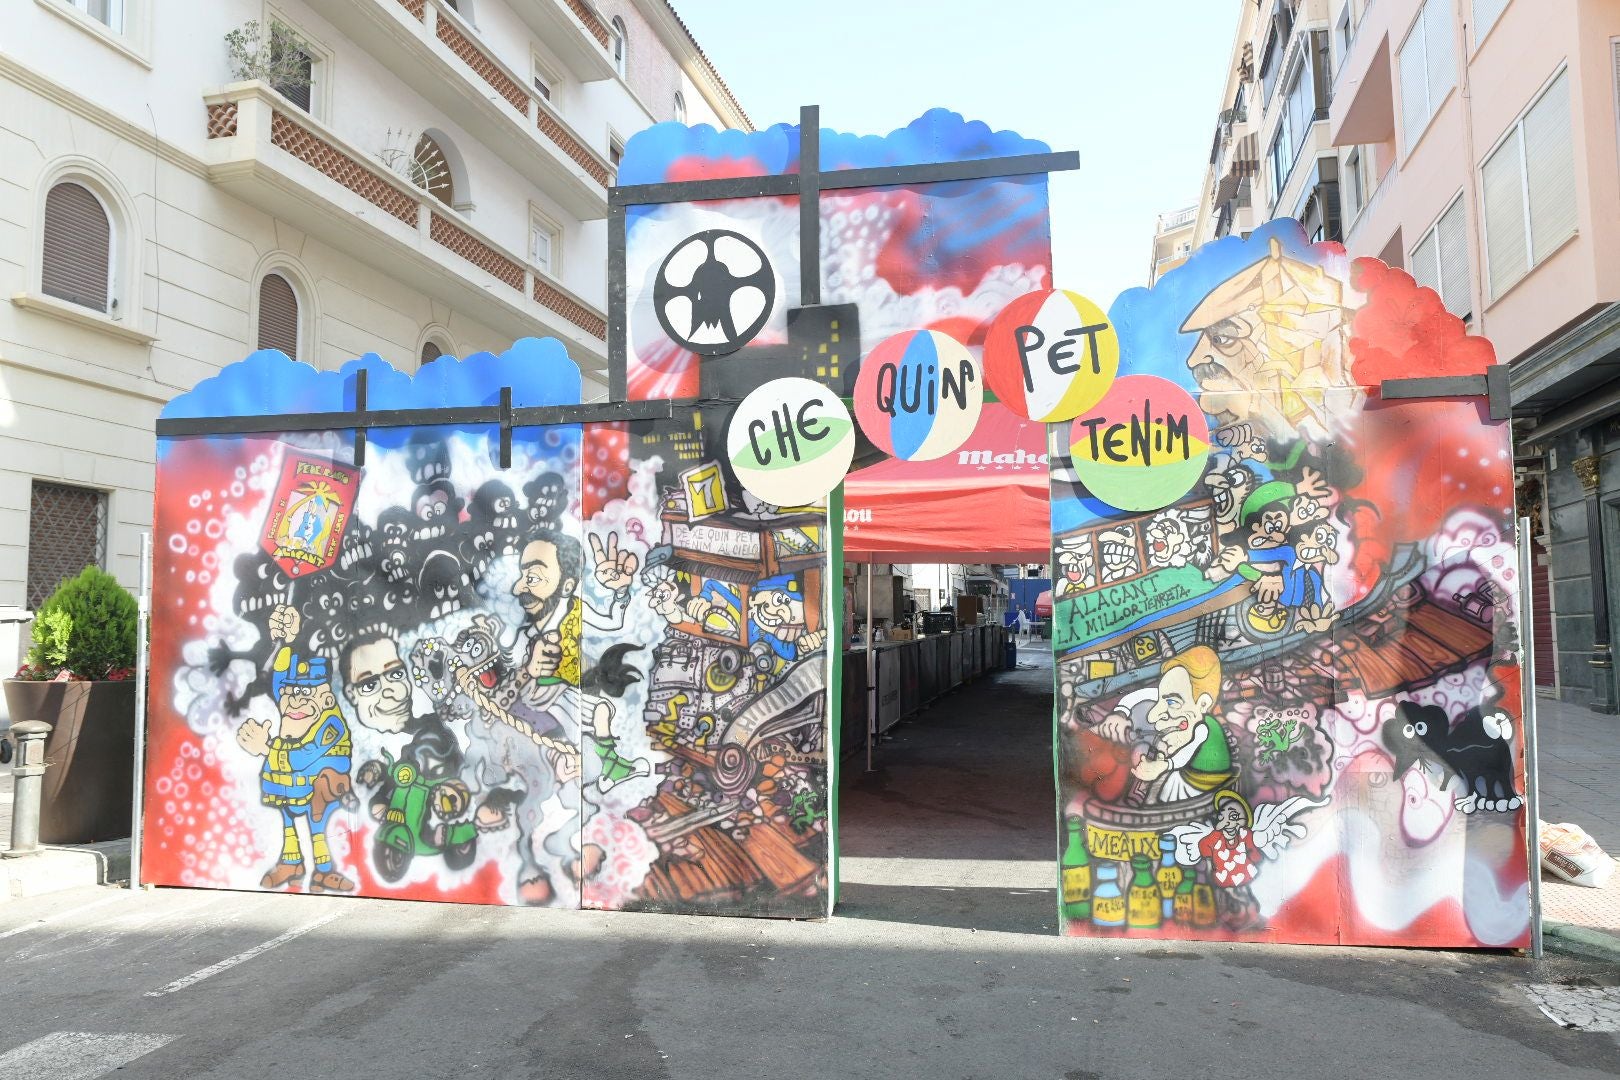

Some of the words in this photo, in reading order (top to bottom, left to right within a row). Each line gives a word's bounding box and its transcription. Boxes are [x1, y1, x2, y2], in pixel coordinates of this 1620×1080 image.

[748, 399, 831, 466] CHE
[1014, 323, 1109, 393] PET
[736, 531, 753, 543] PET
[1069, 574, 1160, 624] ALACANT
[1057, 627, 1080, 645] LA
[1086, 605, 1143, 636] MILLOR
